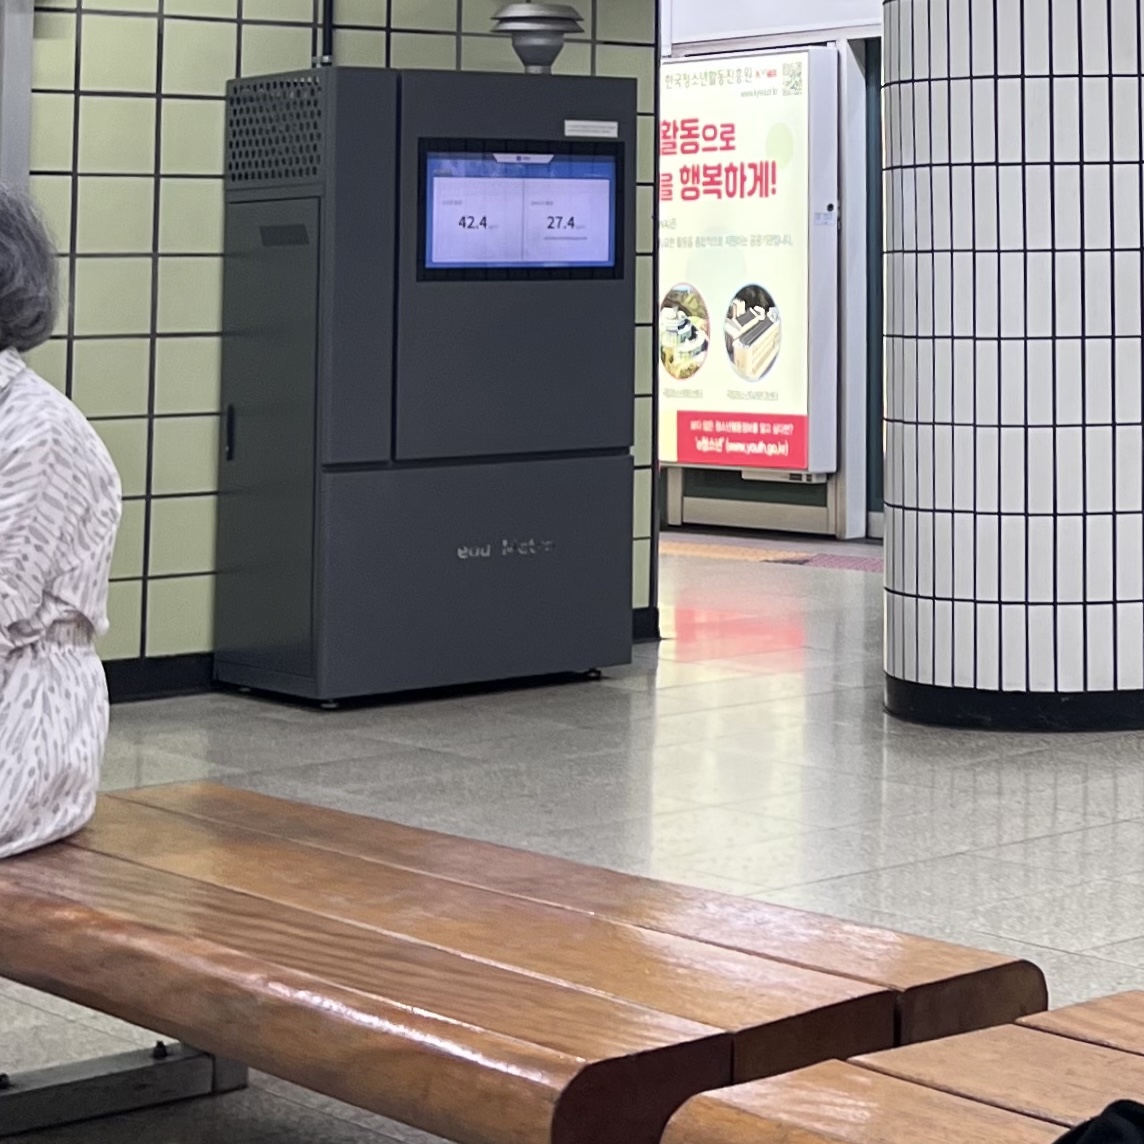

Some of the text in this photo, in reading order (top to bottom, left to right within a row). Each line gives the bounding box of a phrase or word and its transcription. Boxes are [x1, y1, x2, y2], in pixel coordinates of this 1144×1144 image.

[665, 67, 753, 89] 한국청소년활동진흥원
[660, 118, 736, 155] 활동으로
[679, 160, 776, 201] 행복하게!
[458, 216, 488, 230] 42.4
[547, 216, 576, 230] 27.4
